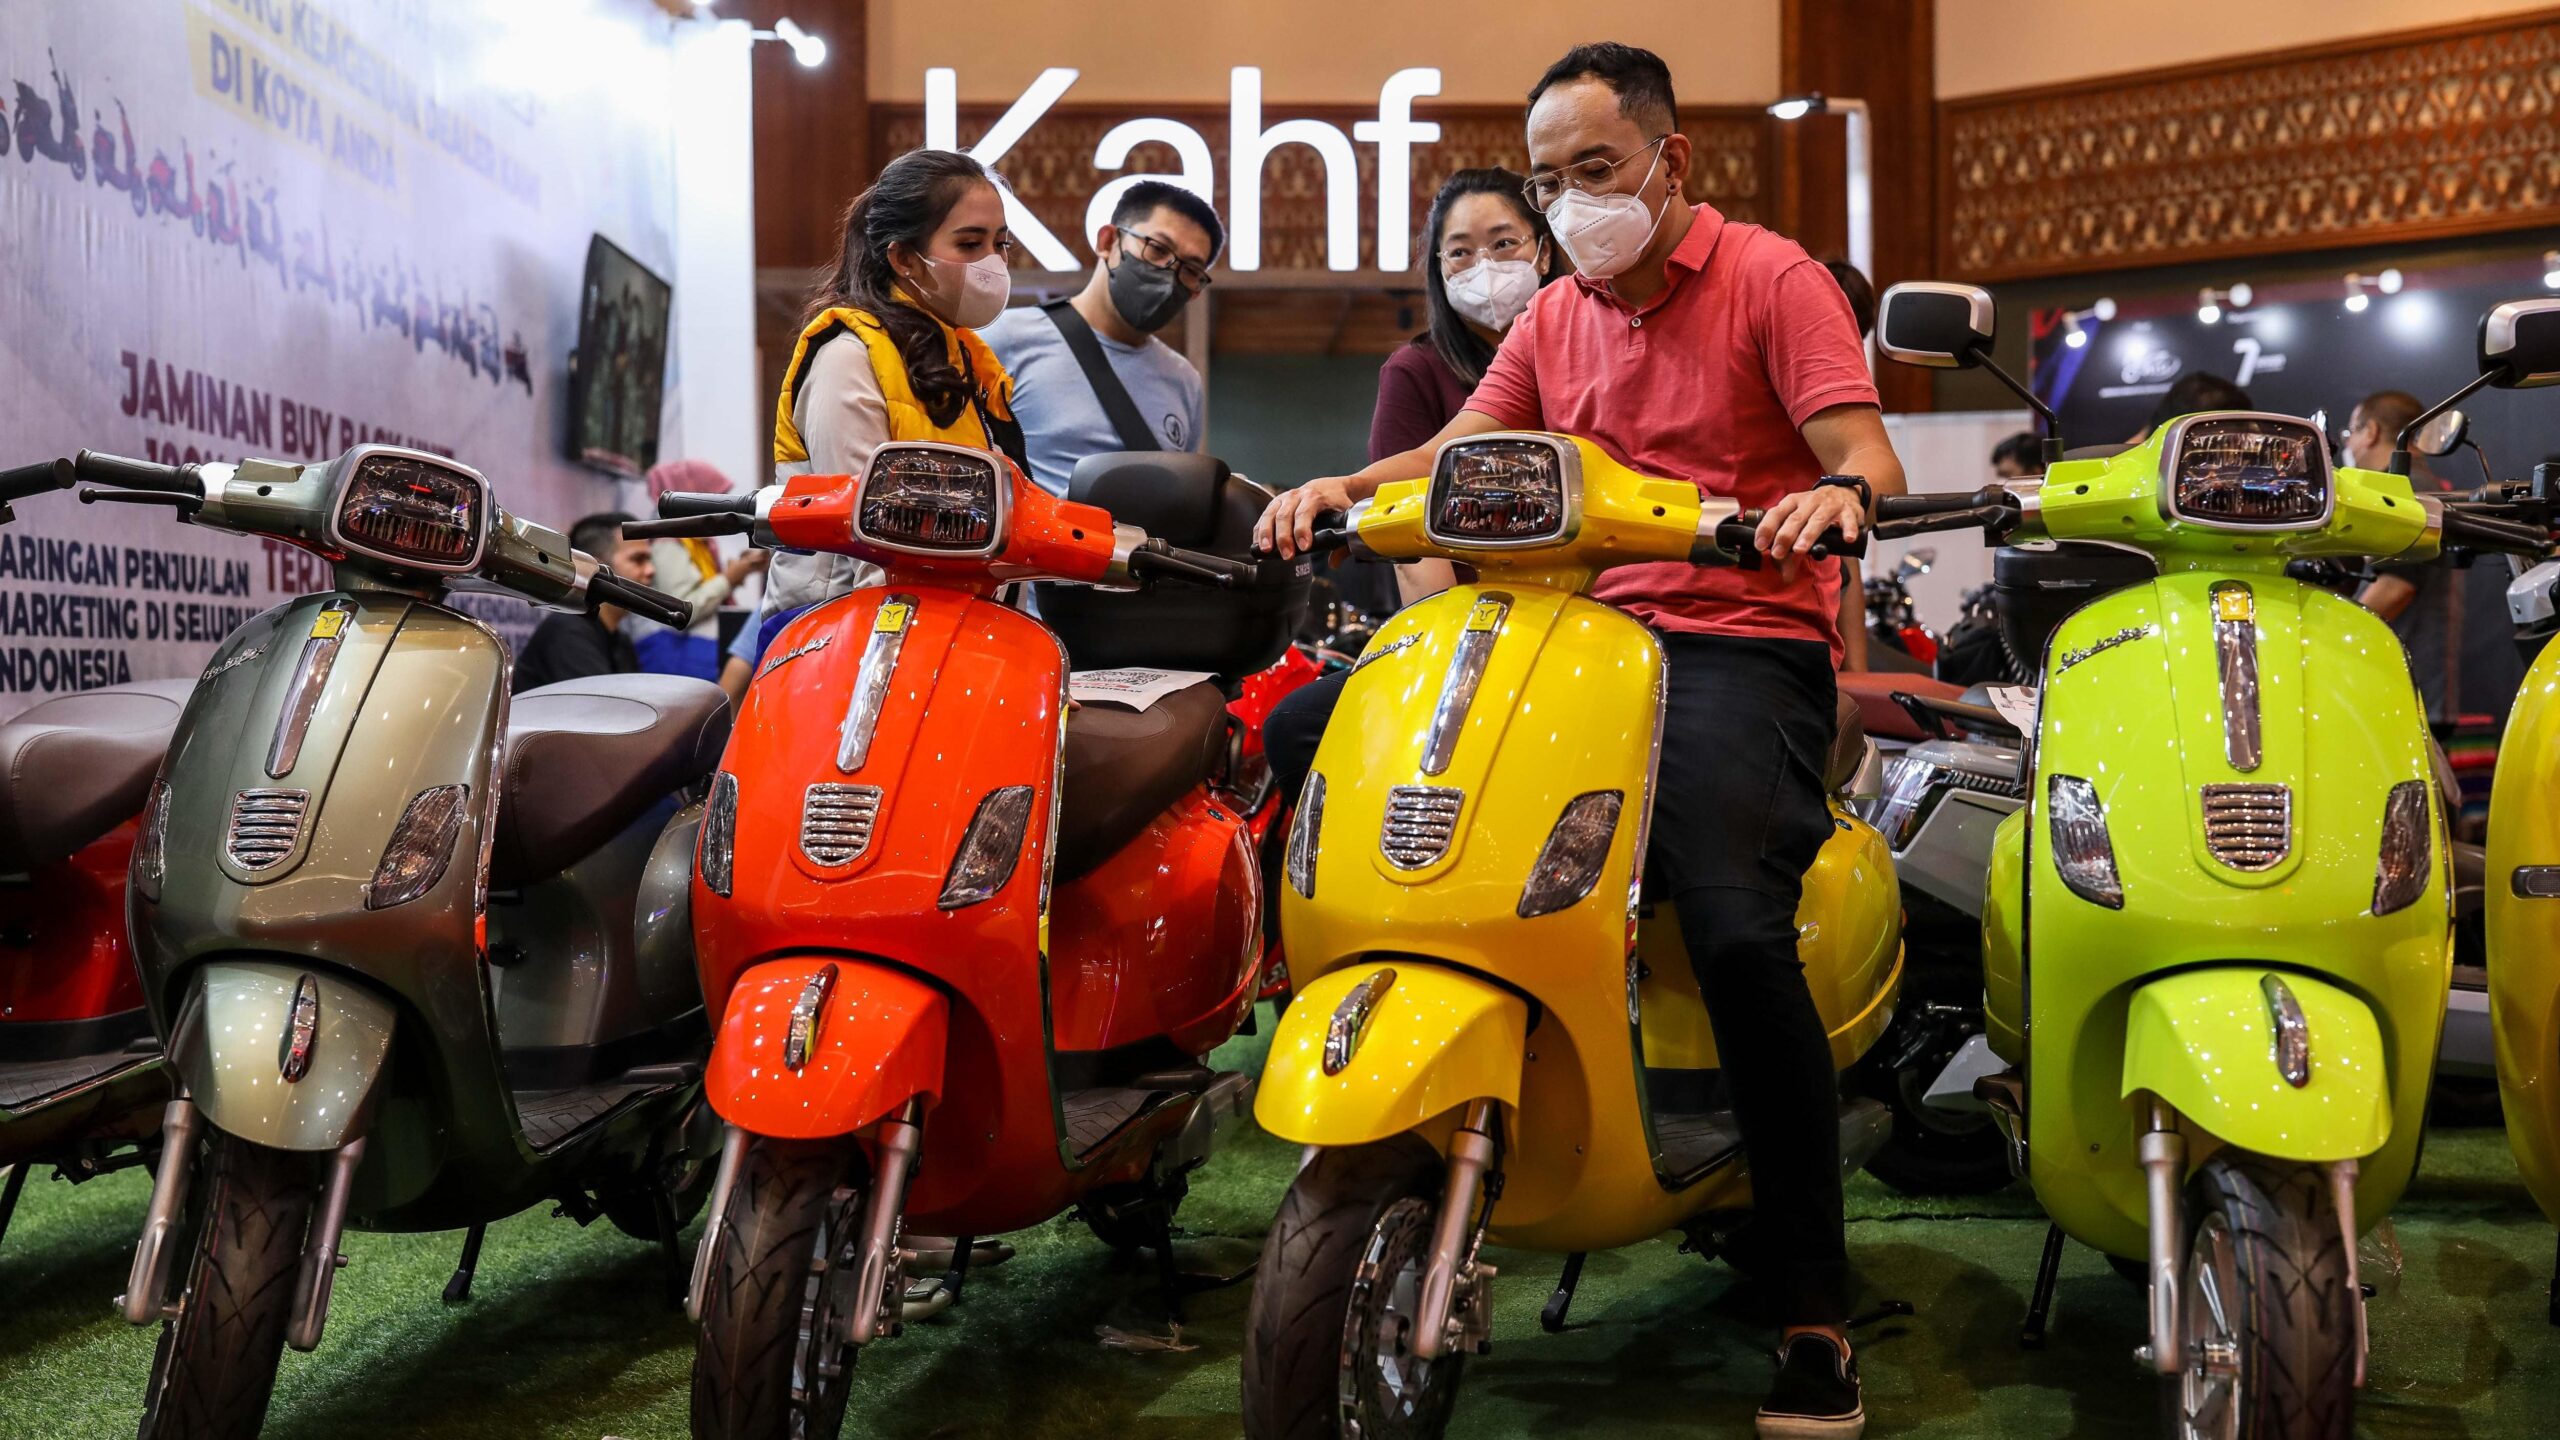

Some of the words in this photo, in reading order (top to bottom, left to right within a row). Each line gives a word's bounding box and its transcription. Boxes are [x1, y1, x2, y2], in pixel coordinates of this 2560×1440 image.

[210, 31, 243, 104] DI
[251, 57, 324, 153] KOTA
[332, 112, 398, 190] ANDA
[924, 65, 1441, 273] Kahf
[120, 350, 273, 449] JAMINAN
[280, 397, 332, 460] BUY
[125, 548, 249, 597] PENJUALAN
[262, 536, 334, 592] TERJ
[145, 606, 170, 641] DI
[174, 602, 264, 643] SELUR
